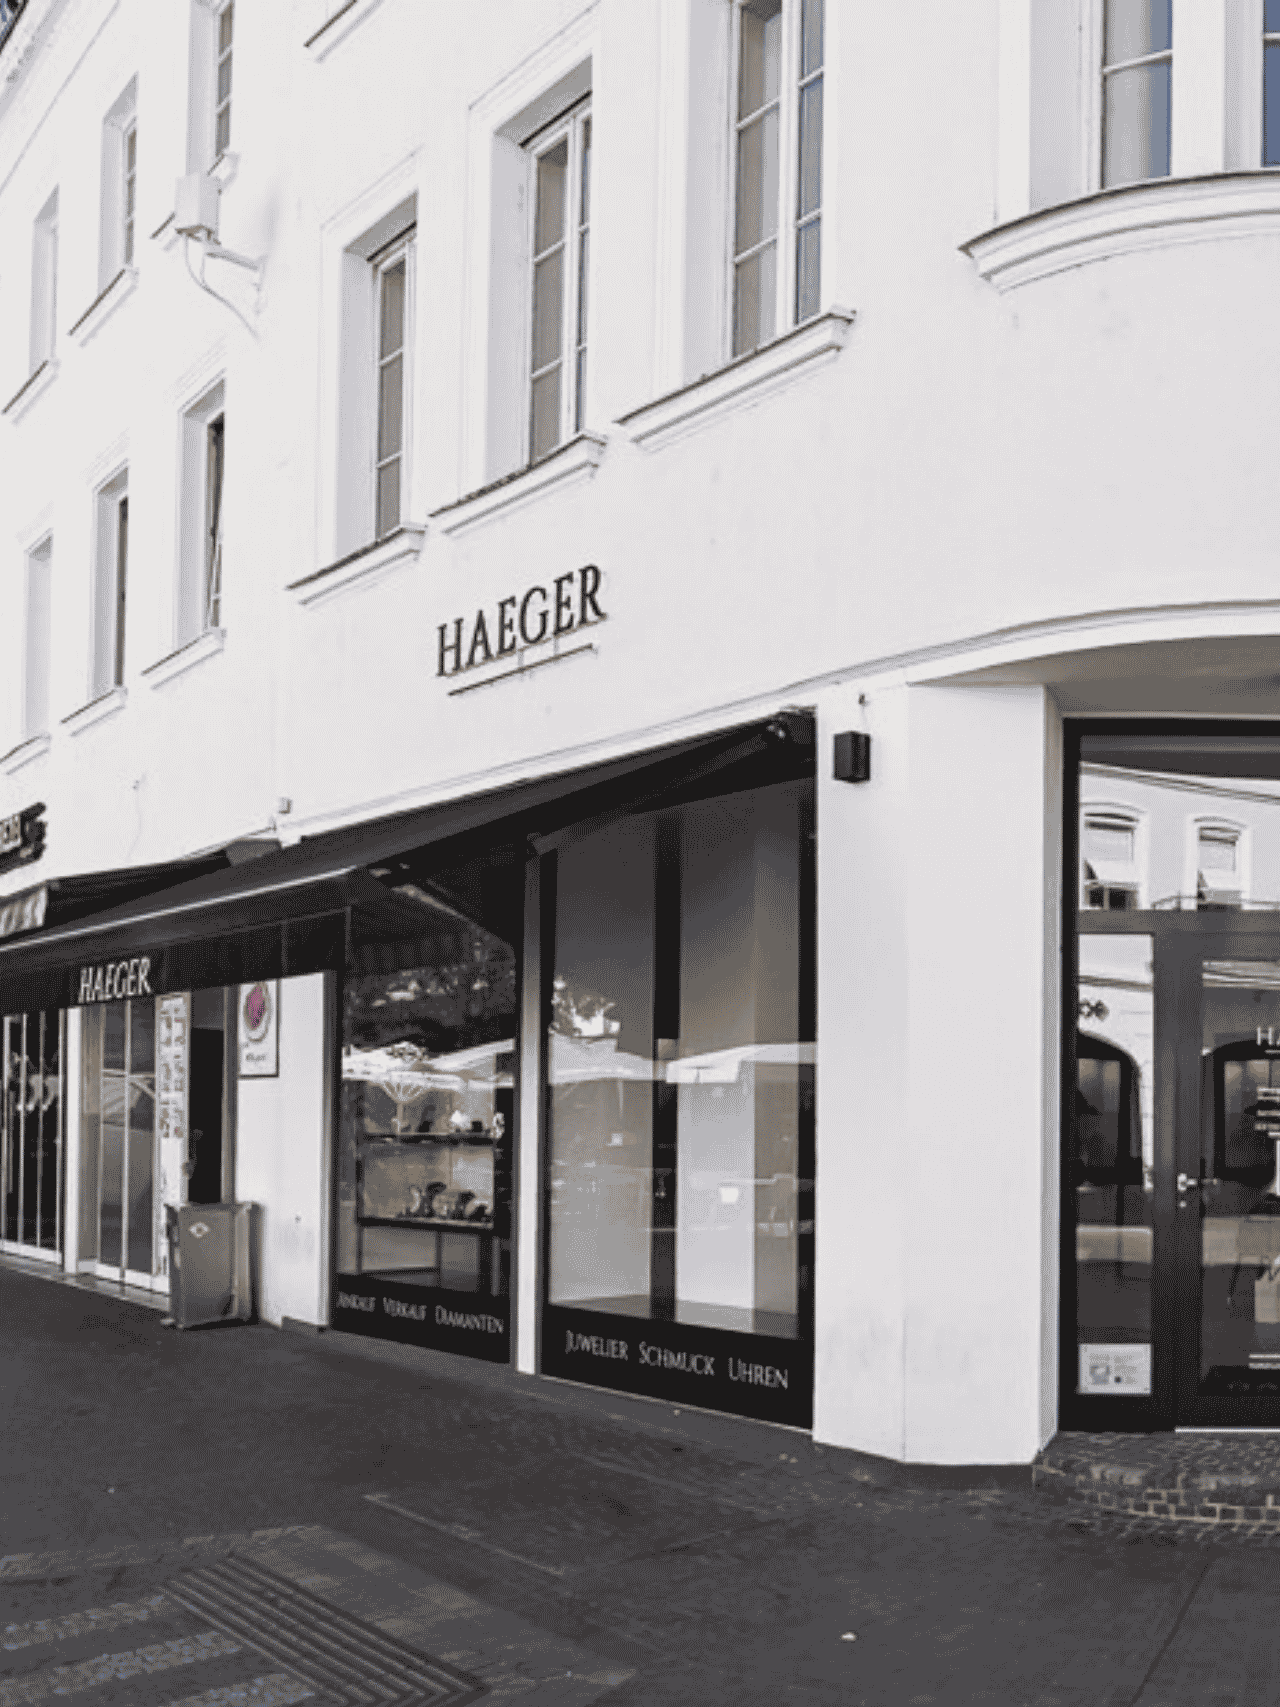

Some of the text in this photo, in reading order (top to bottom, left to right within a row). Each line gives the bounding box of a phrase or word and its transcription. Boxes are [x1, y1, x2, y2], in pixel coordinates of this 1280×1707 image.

[436, 564, 608, 678] HAEGER
[78, 956, 151, 1003] HAEGER
[435, 1305, 504, 1334] DIAMANTEN
[565, 1330, 789, 1390] JUWELIER SCHMUCK UHREN
